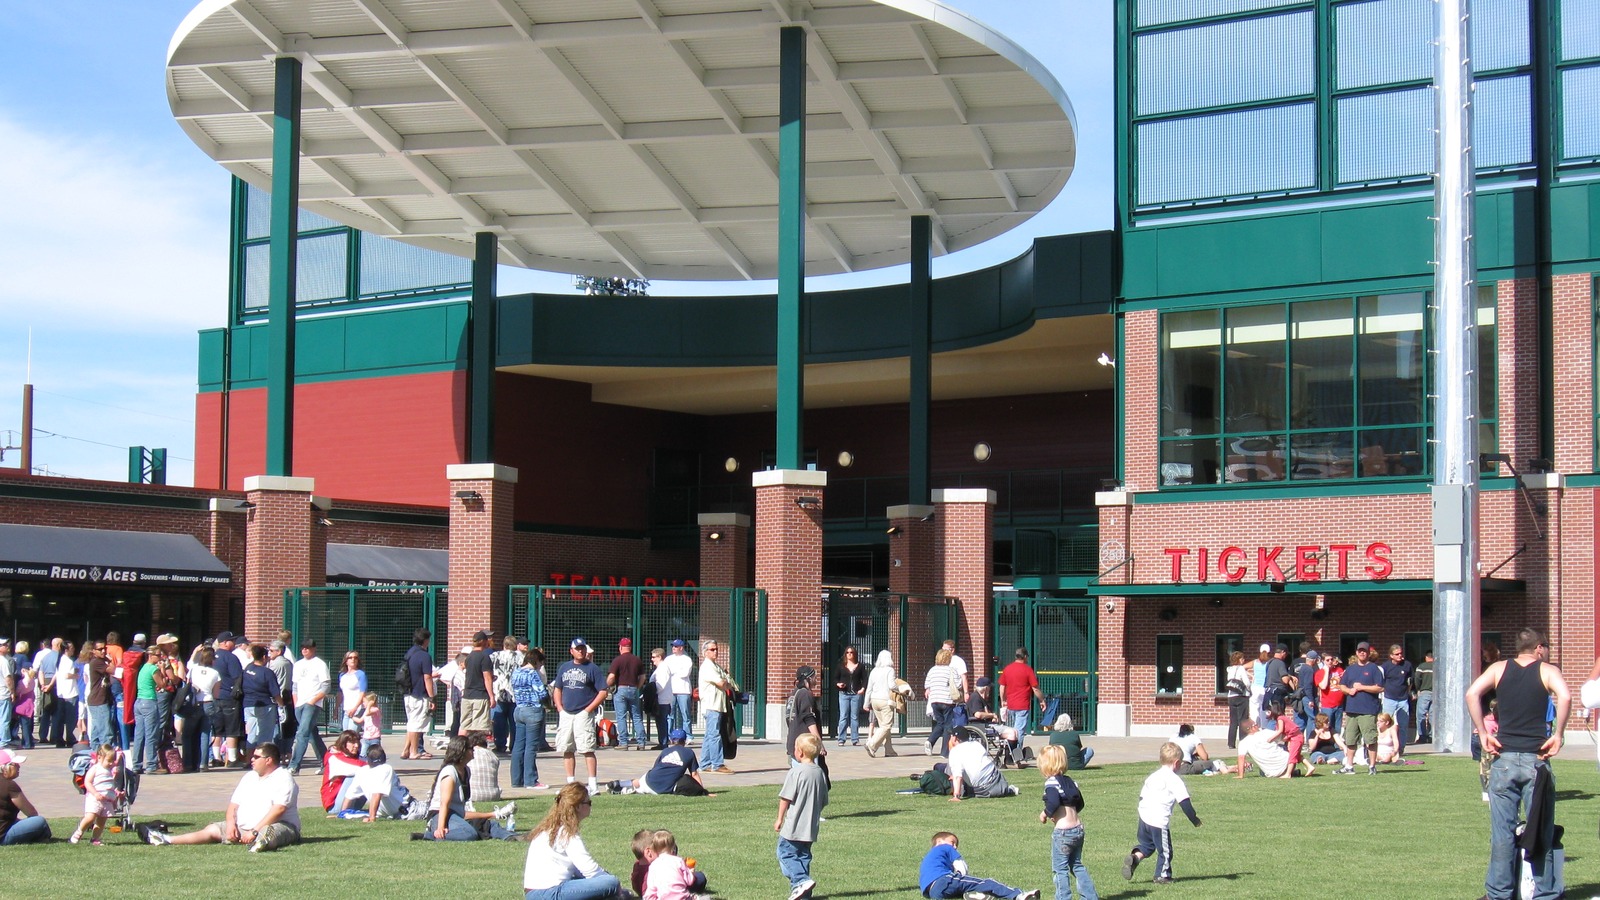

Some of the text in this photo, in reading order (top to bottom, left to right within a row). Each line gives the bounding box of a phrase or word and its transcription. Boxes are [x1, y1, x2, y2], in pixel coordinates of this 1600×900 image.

[1164, 542, 1394, 582] TICKETS
[17, 567, 48, 576] KEEPSAKES
[50, 566, 87, 580] RENO
[103, 568, 137, 581] ACES
[140, 573, 168, 581] SOUVENIRS
[171, 574, 199, 582] MEMENTOS
[367, 580, 397, 592] RENO
[550, 573, 629, 601] TEAM
